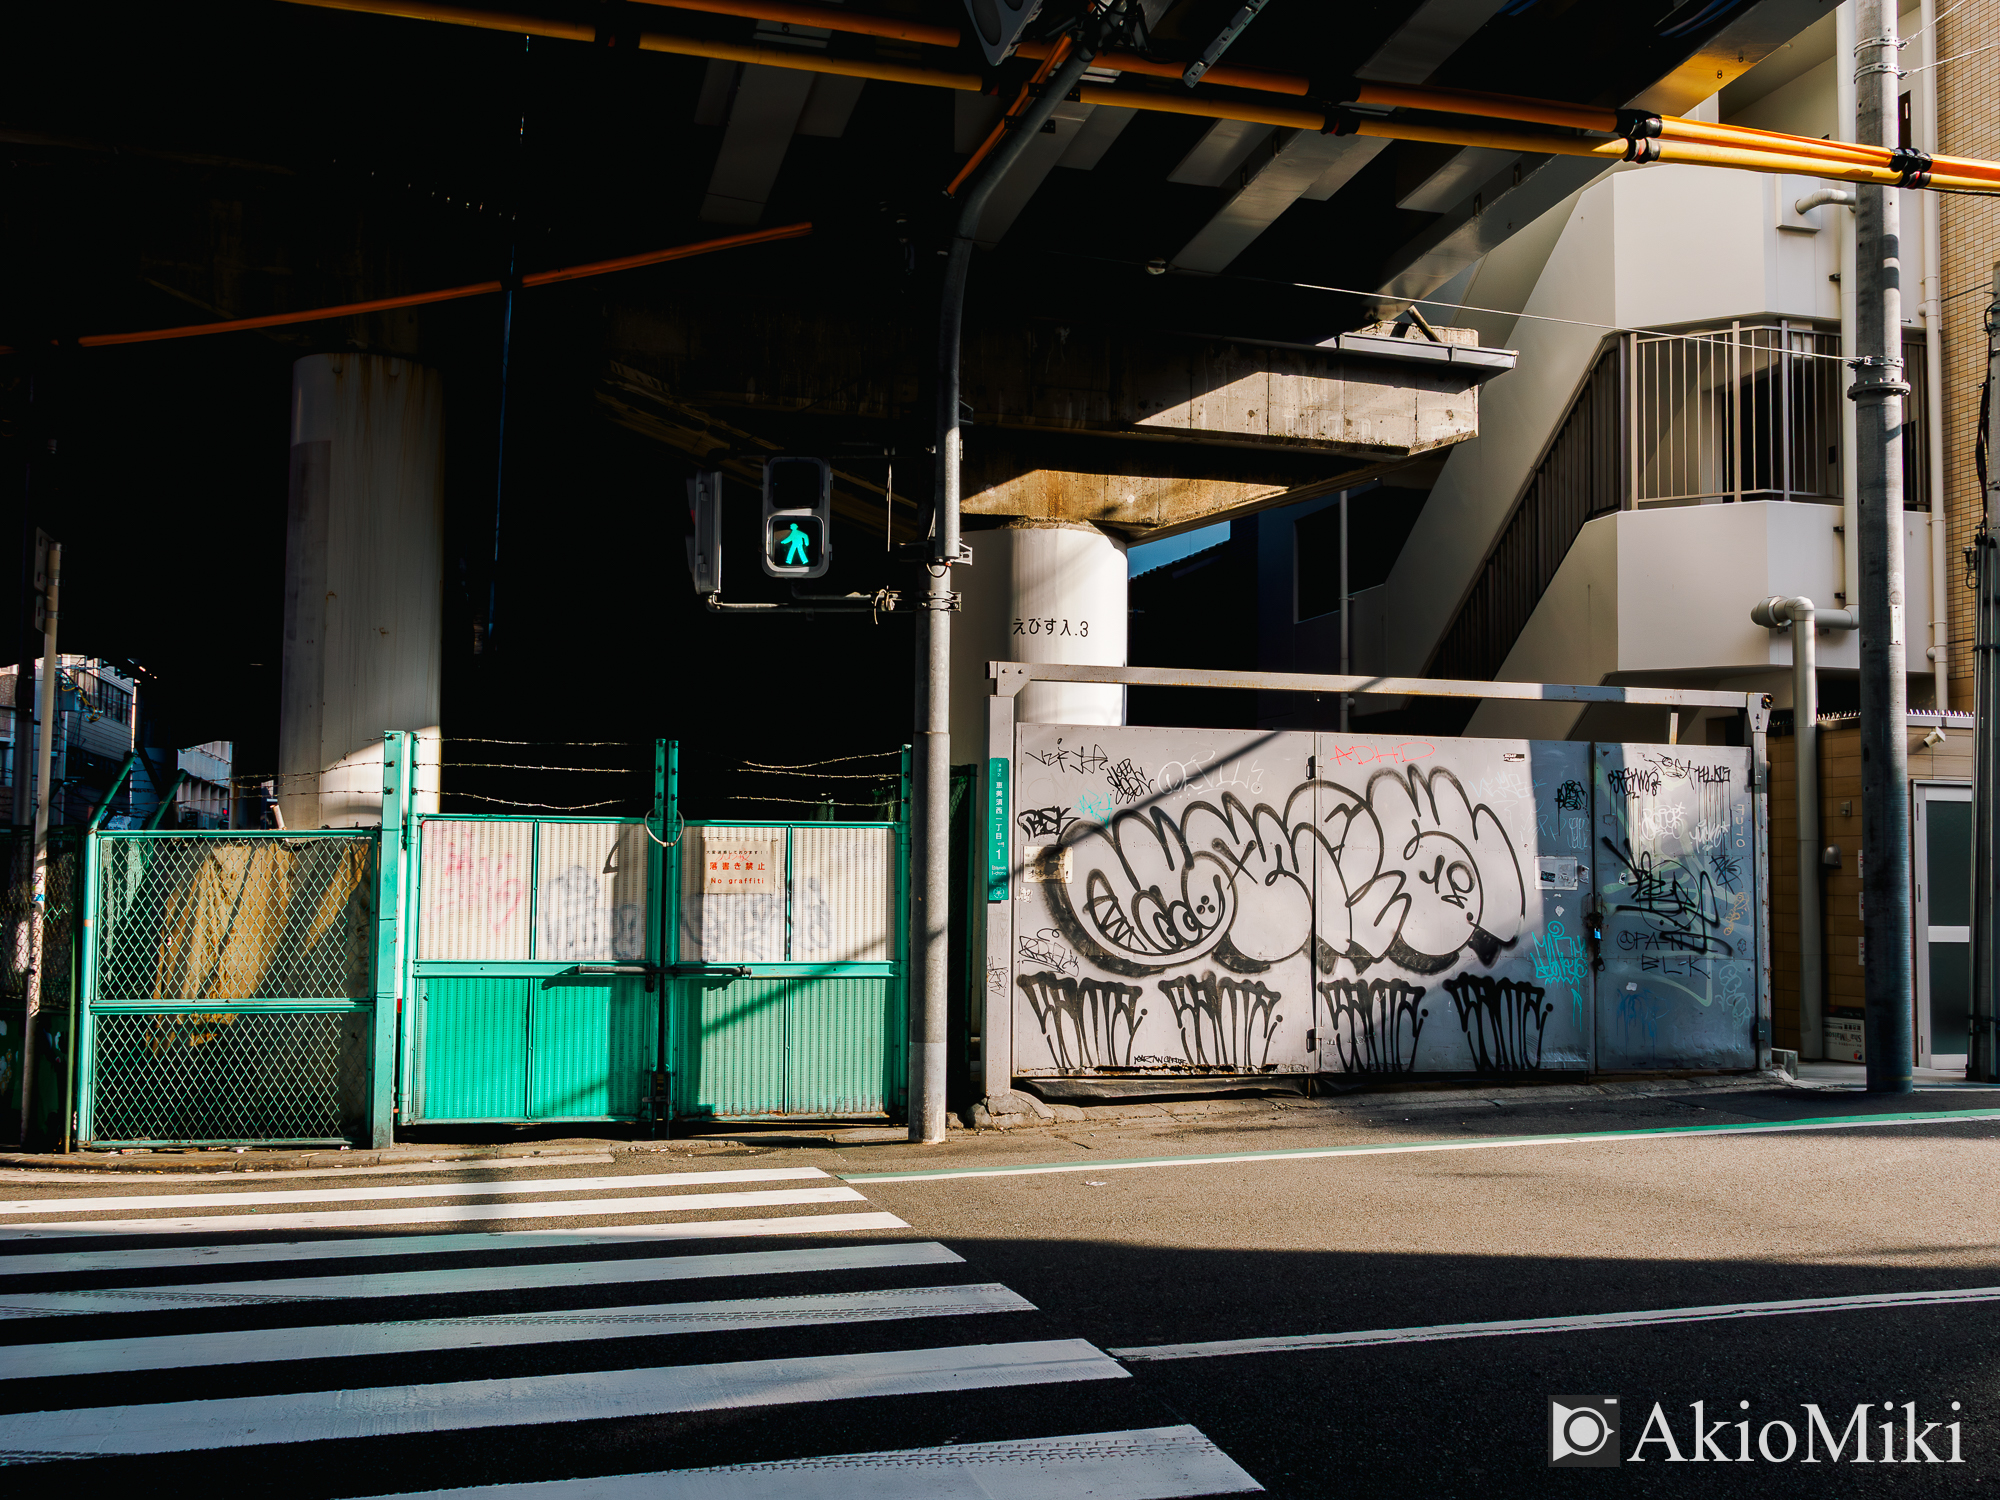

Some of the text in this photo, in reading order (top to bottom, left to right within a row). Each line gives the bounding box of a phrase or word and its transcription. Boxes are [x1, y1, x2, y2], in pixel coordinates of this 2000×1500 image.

[1330, 741, 1435, 765] ADHD
[709, 861, 766, 871] 落書き禁止
[728, 877, 765, 885] graffiti
